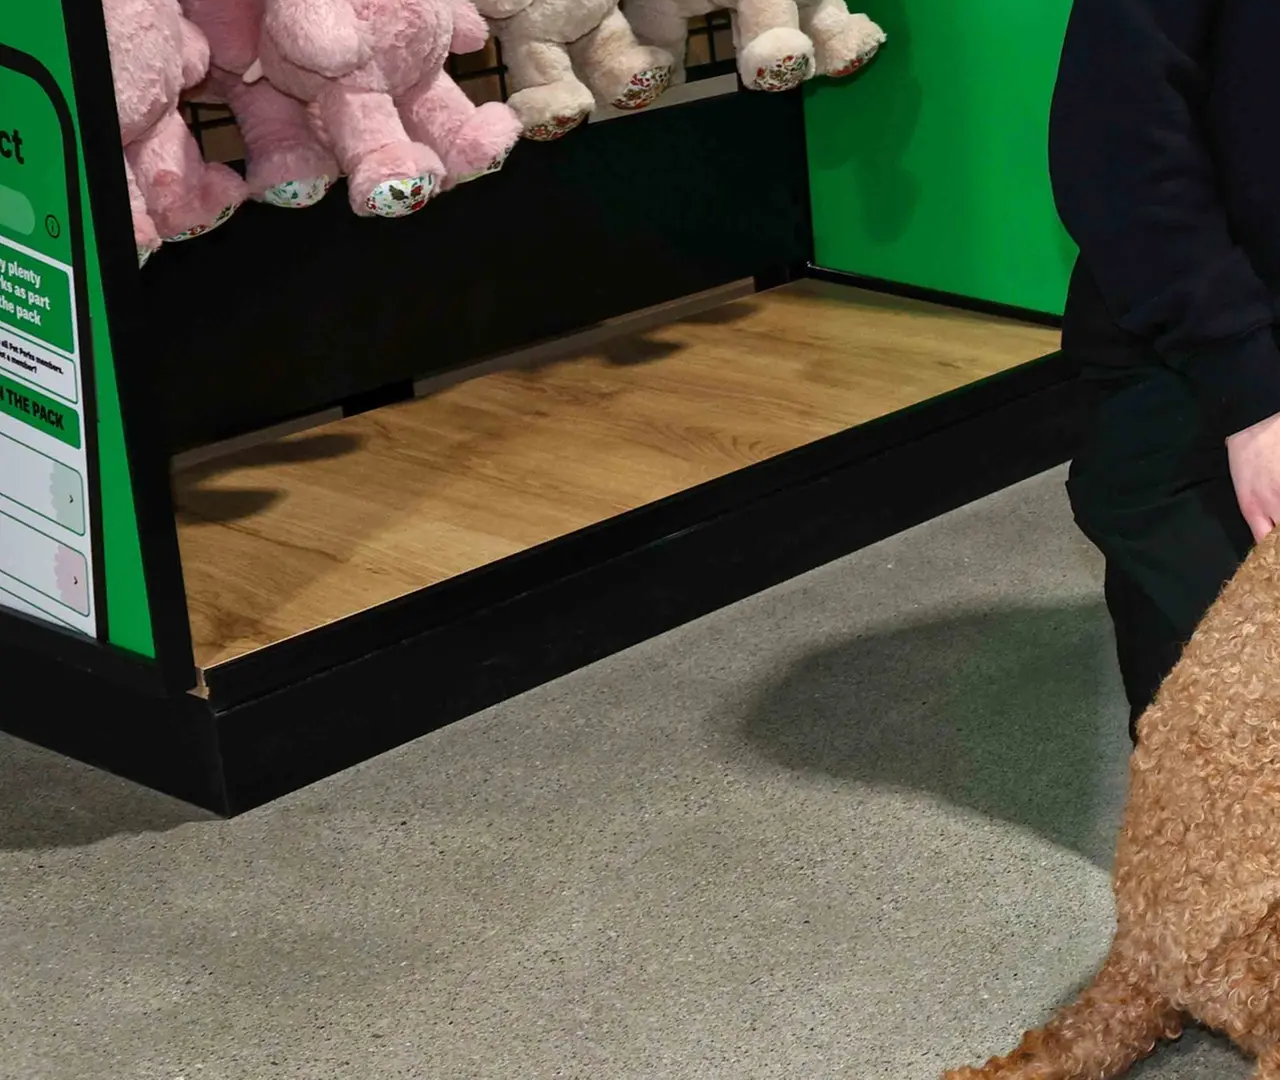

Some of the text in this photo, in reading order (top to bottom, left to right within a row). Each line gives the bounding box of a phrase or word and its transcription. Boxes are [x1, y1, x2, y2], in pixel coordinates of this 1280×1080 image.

[8, 261, 41, 289] plenty
[14, 285, 51, 310] as part
[16, 305, 42, 326] pack
[6, 387, 65, 431] THE PACK
